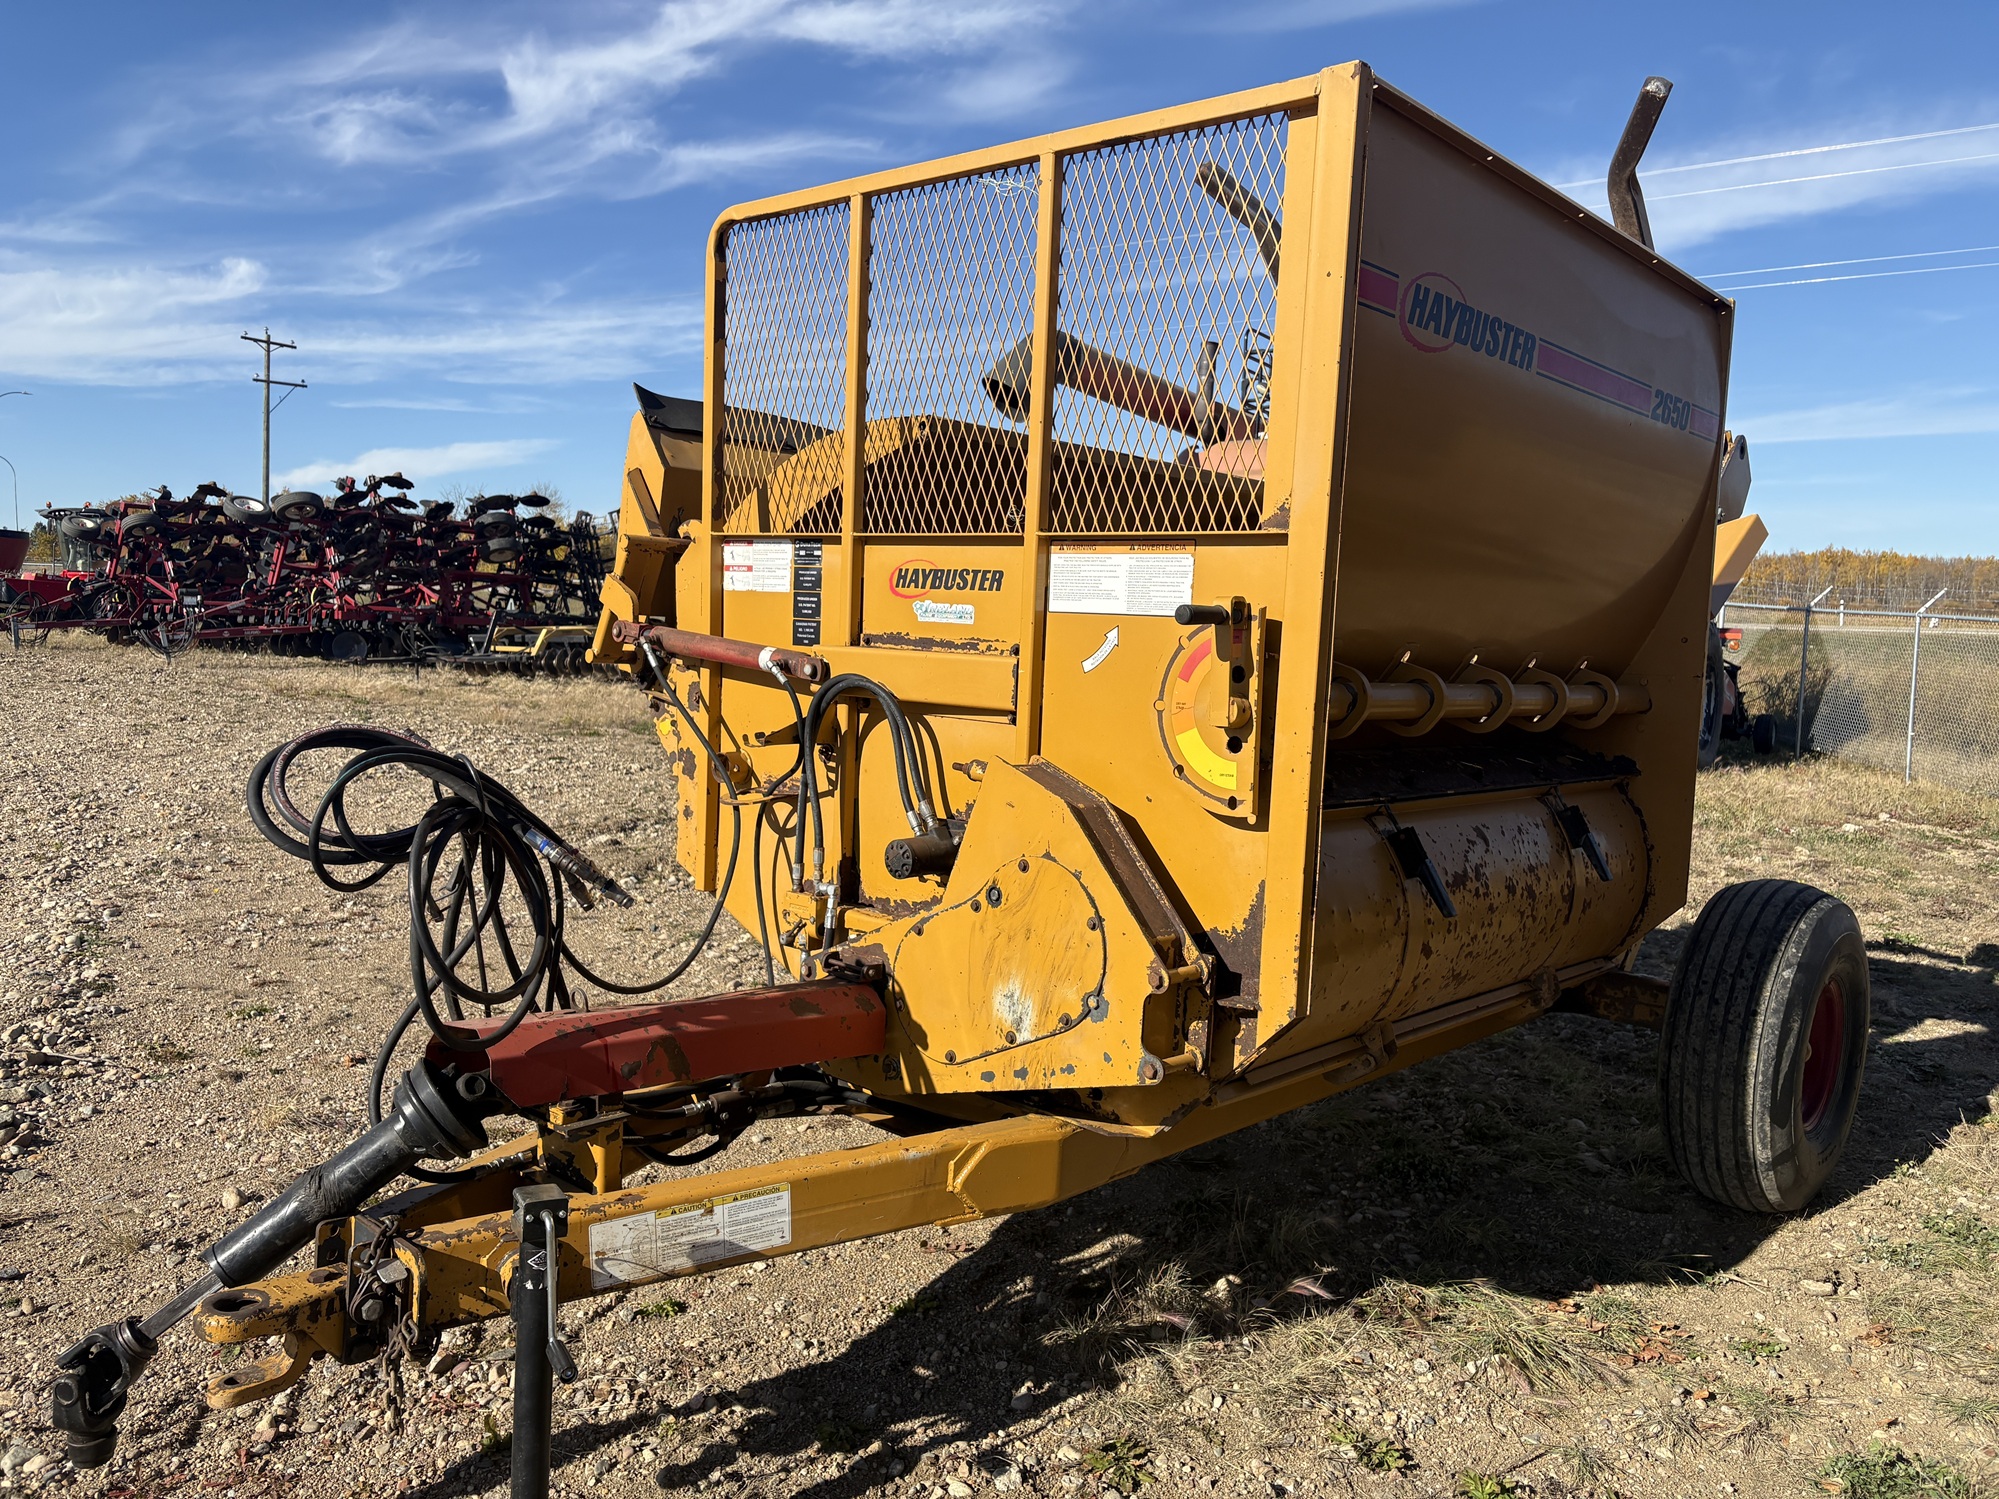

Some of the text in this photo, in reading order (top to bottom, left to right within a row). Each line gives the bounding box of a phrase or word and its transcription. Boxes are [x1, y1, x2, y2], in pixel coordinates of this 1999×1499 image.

[1407, 282, 1537, 372] HAYBUSTER
[1650, 388, 1691, 431] 2650
[1136, 543, 1187, 551] ADVERTENCIA
[895, 568, 1005, 592] HAYBUSTER
[739, 1186, 781, 1200] PRECAUCIÓN
[678, 1202, 707, 1214] CAUTION
